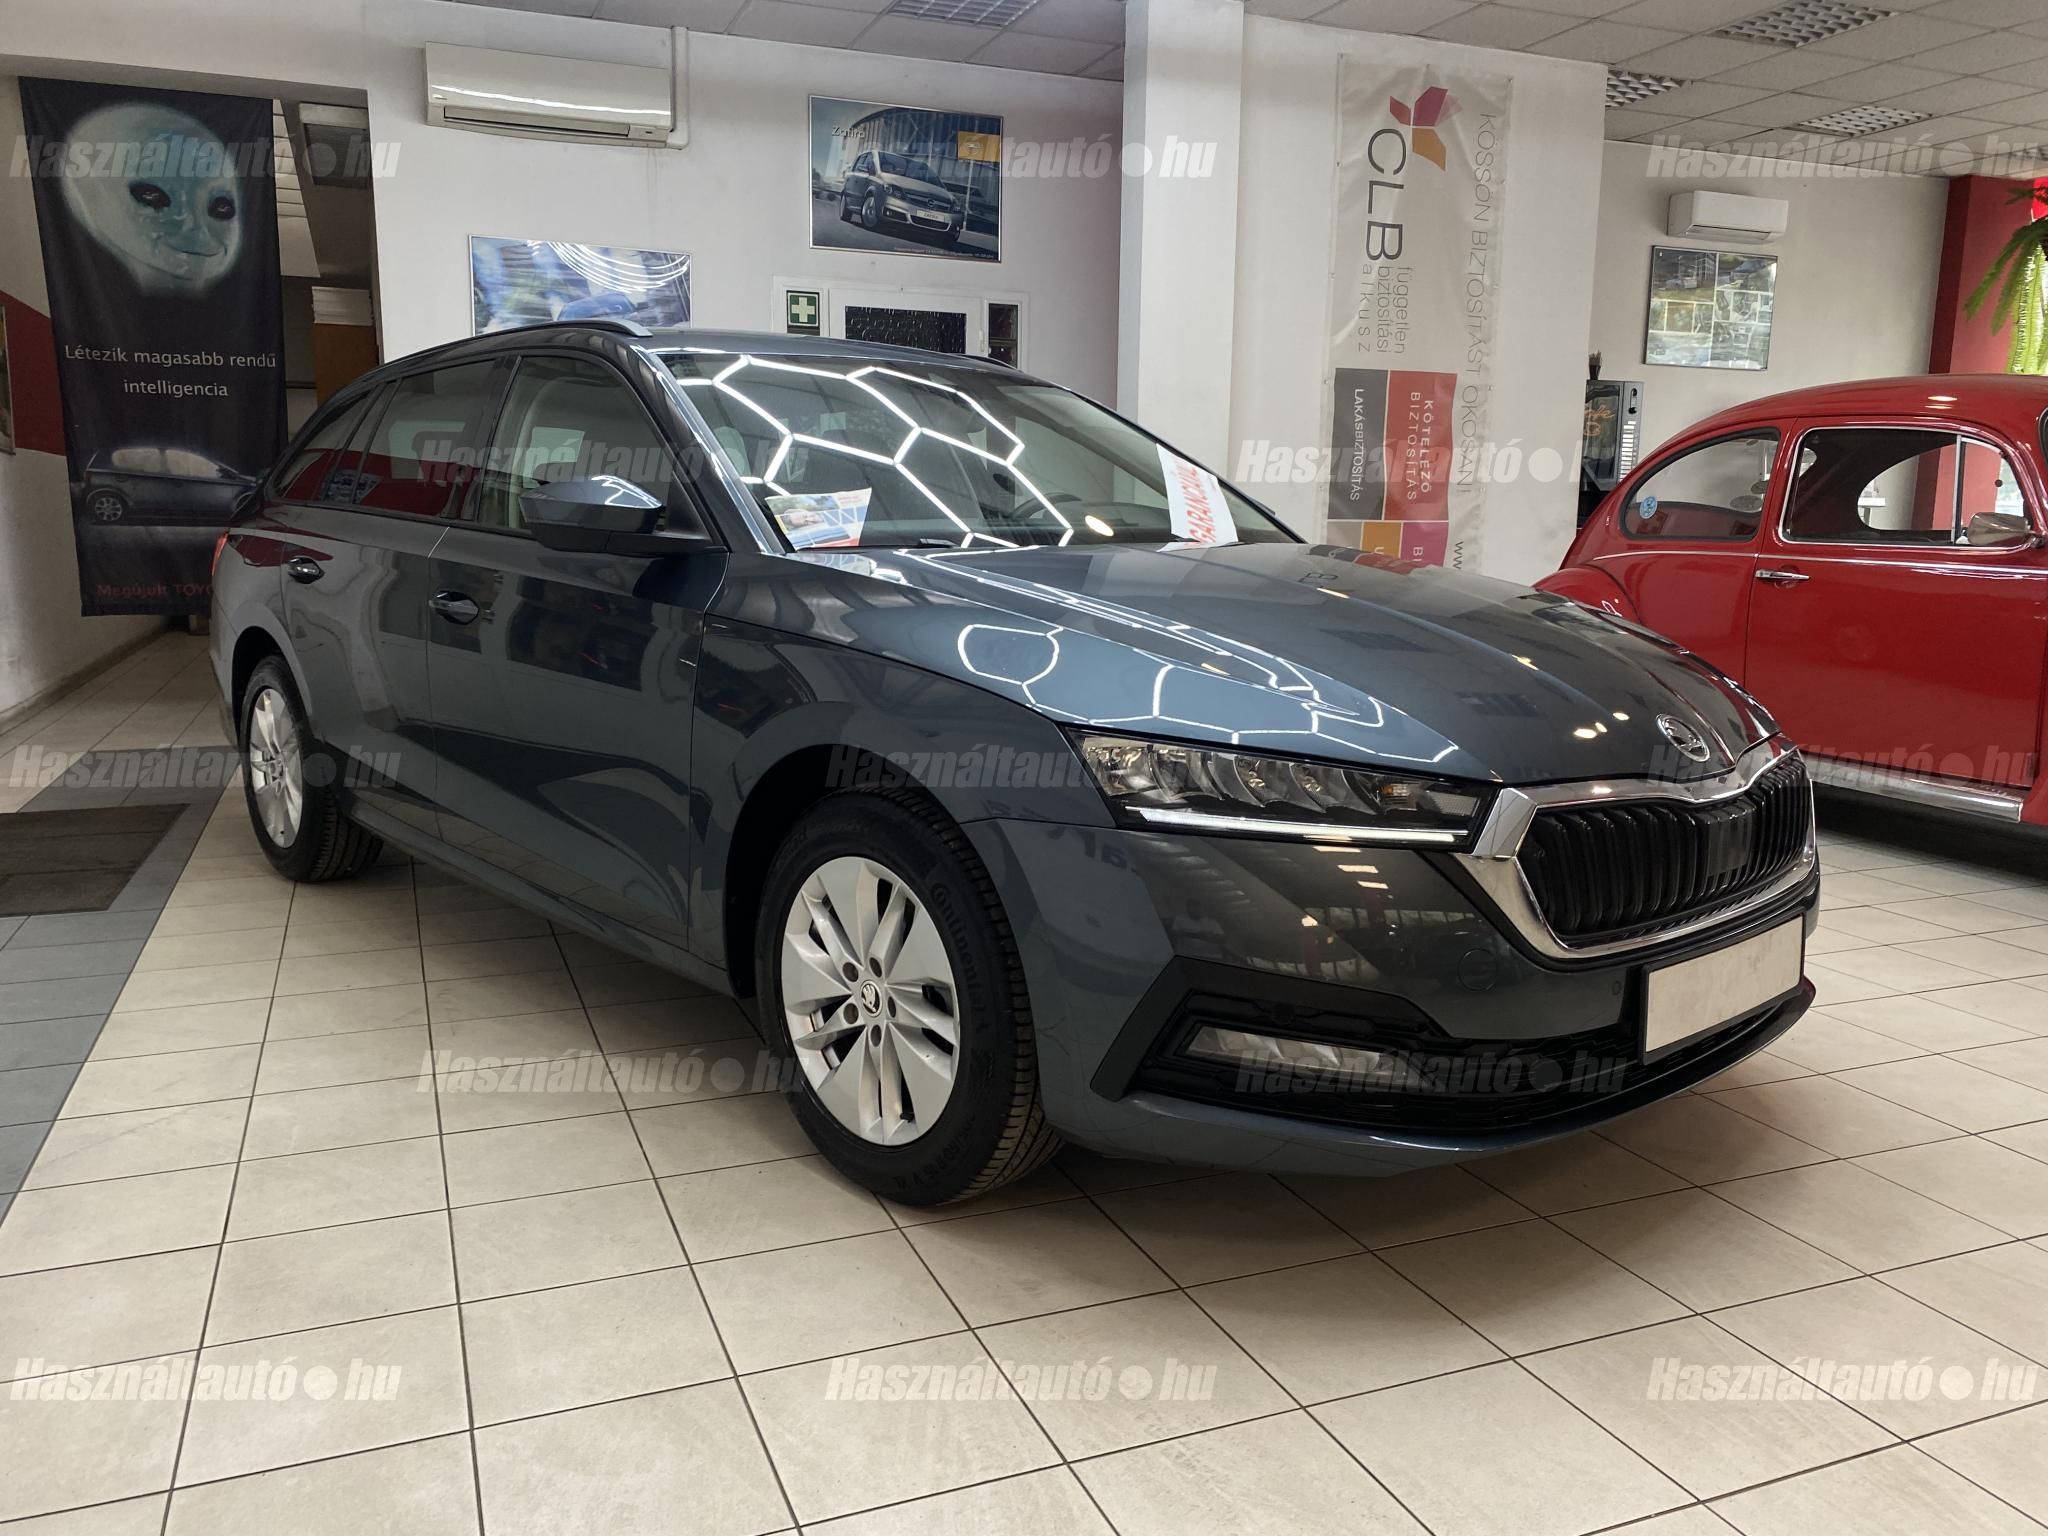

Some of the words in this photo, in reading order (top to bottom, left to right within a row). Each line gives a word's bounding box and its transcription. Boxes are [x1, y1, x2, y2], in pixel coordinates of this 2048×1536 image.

[1366, 128, 1407, 261] CLB
[1377, 266, 1395, 353] biztosítási
[1392, 266, 1413, 354] független
[1466, 230, 1488, 376] BIZTOSÍTÁST
[65, 345, 128, 362] Létezik
[134, 351, 224, 367] magasabb
[230, 353, 276, 367] rendű
[123, 379, 228, 398] intelligencia
[1351, 388, 1365, 501] LAKÁSBIZTOSÍTÁS
[1406, 391, 1420, 500] BIZTOSÍTÁS
